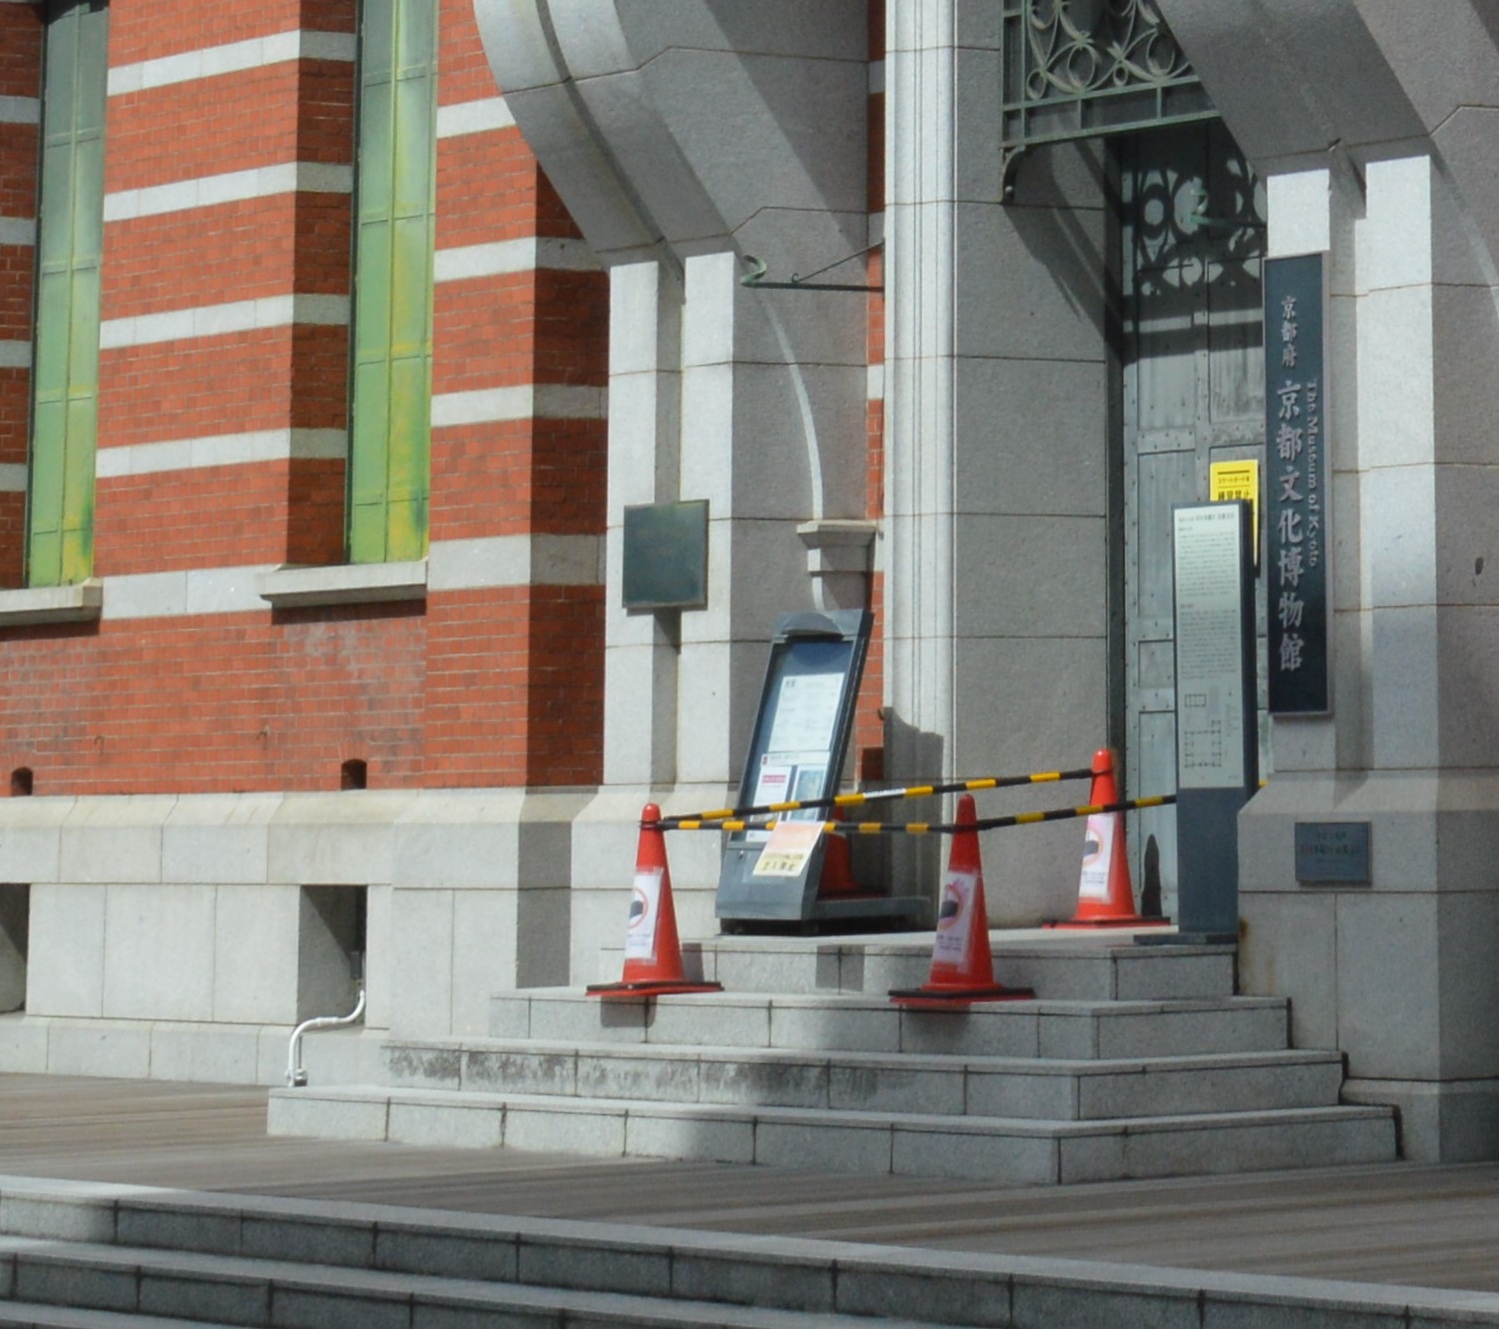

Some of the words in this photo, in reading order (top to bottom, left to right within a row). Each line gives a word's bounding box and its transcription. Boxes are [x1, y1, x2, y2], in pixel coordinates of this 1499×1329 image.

[1281, 295, 1298, 369] 京都府
[1306, 380, 1318, 413] The
[1307, 416, 1319, 489] Museum
[1275, 380, 1306, 672] 京都文化博物館
[1307, 493, 1321, 512] of
[1307, 515, 1320, 567] Kyoto
